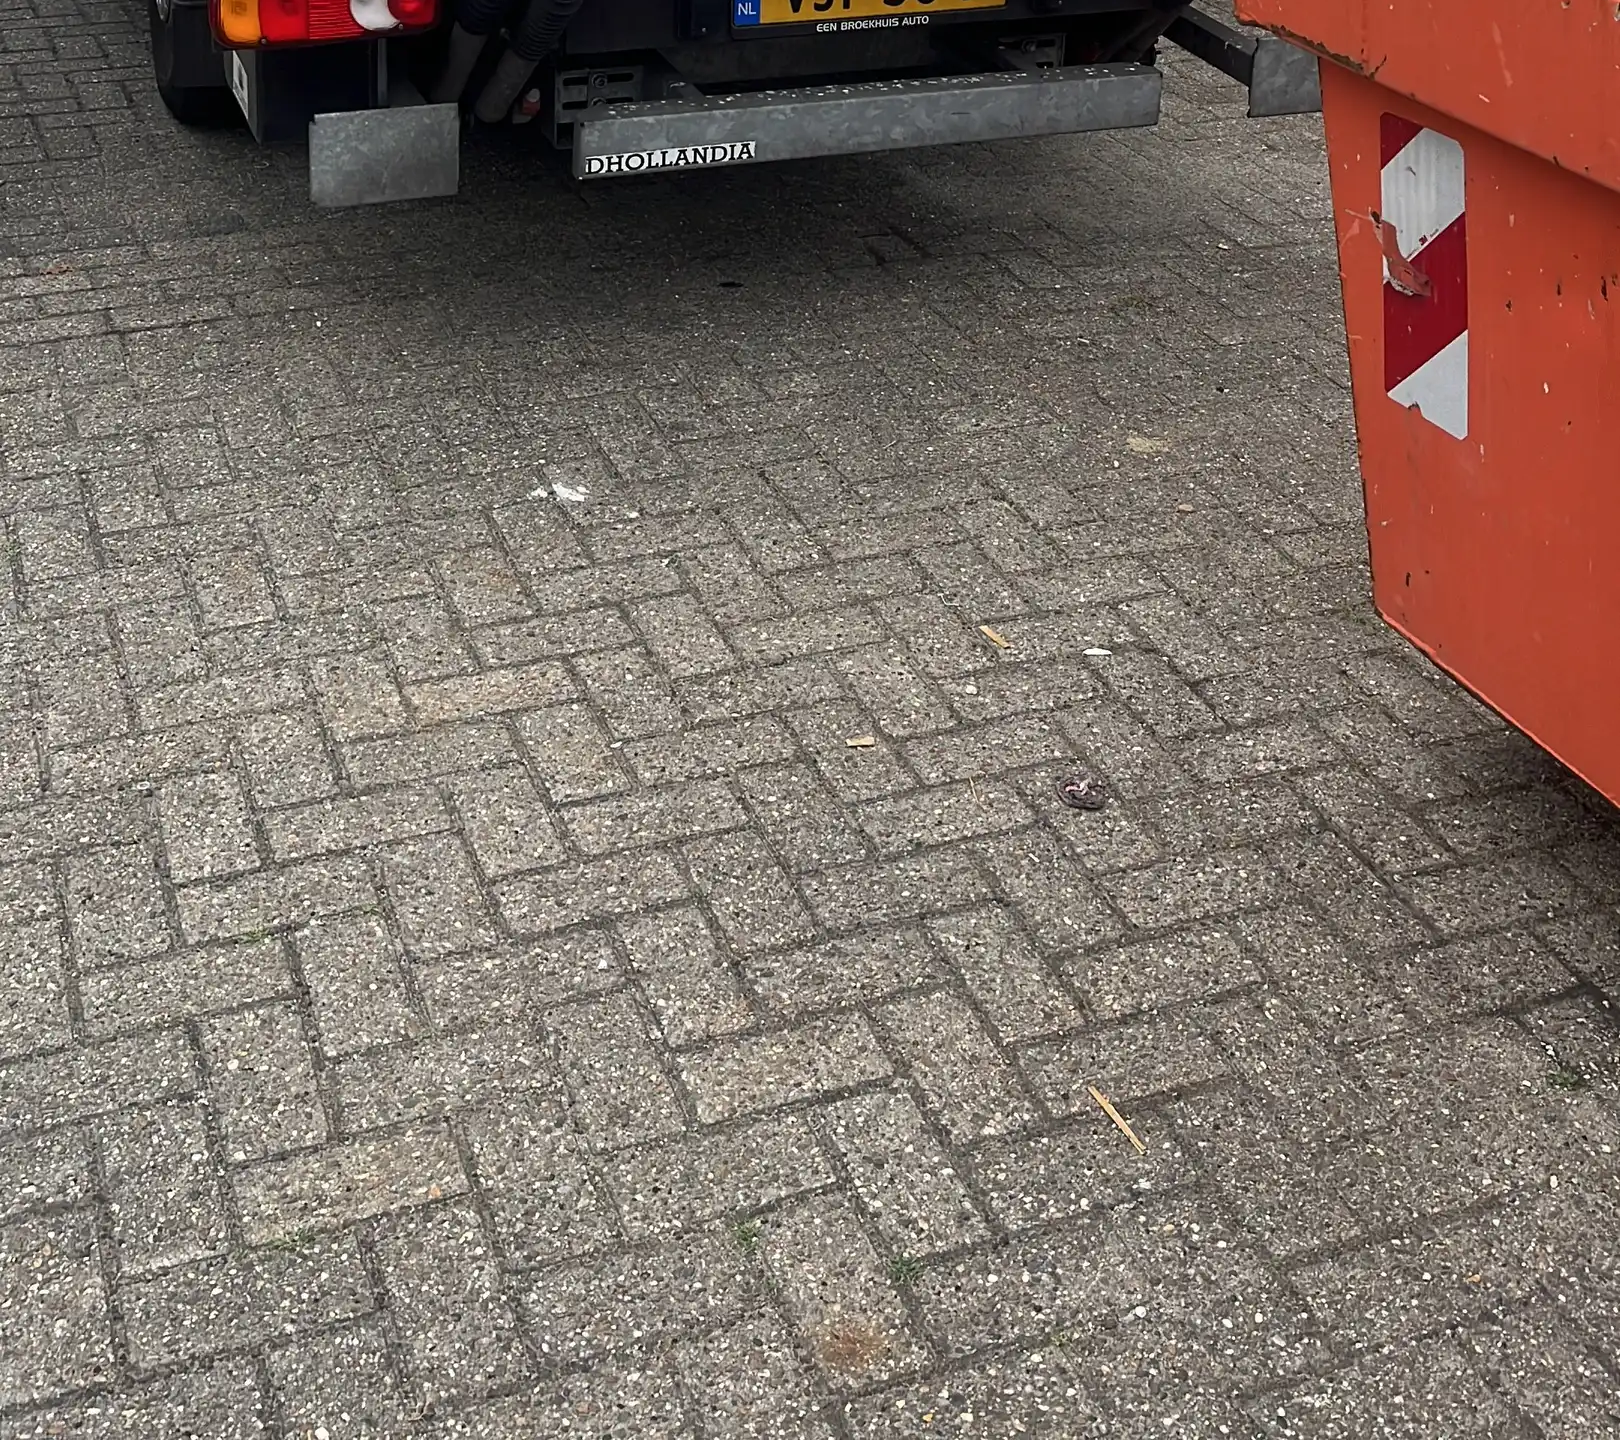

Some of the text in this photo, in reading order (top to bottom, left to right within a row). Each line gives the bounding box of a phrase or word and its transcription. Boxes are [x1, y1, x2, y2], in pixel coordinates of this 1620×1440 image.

[738, 2, 757, 16] NL
[816, 15, 929, 33] EEN BROEKHUIS AUTO
[586, 143, 754, 175] DHOLLANDIA
